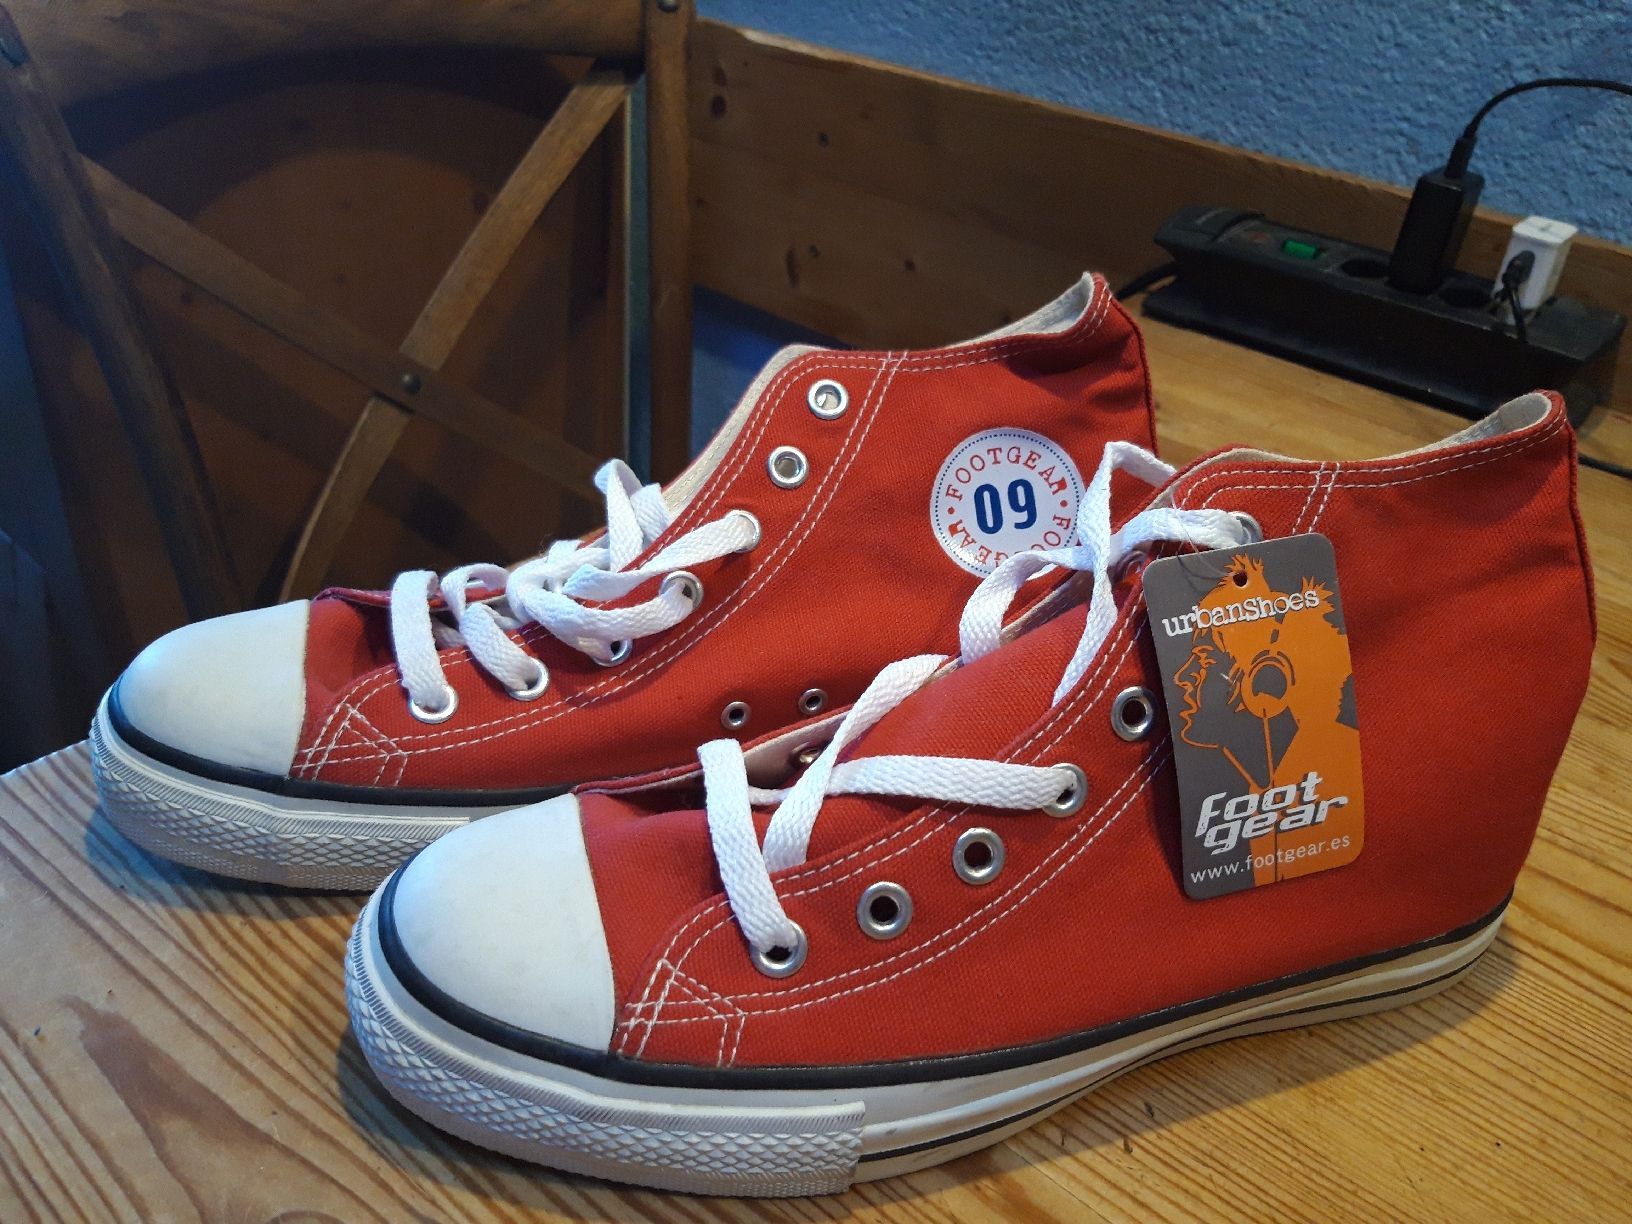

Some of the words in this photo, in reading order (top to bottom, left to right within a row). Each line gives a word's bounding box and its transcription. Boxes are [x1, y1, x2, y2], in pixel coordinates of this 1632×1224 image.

[945, 446, 1068, 502] FOOTGEAR
[973, 478, 1037, 535] 09
[947, 514, 1072, 568] FOGEAR
[1203, 796, 1349, 856] gear
[1190, 835, 1351, 884] www.footgear.es
